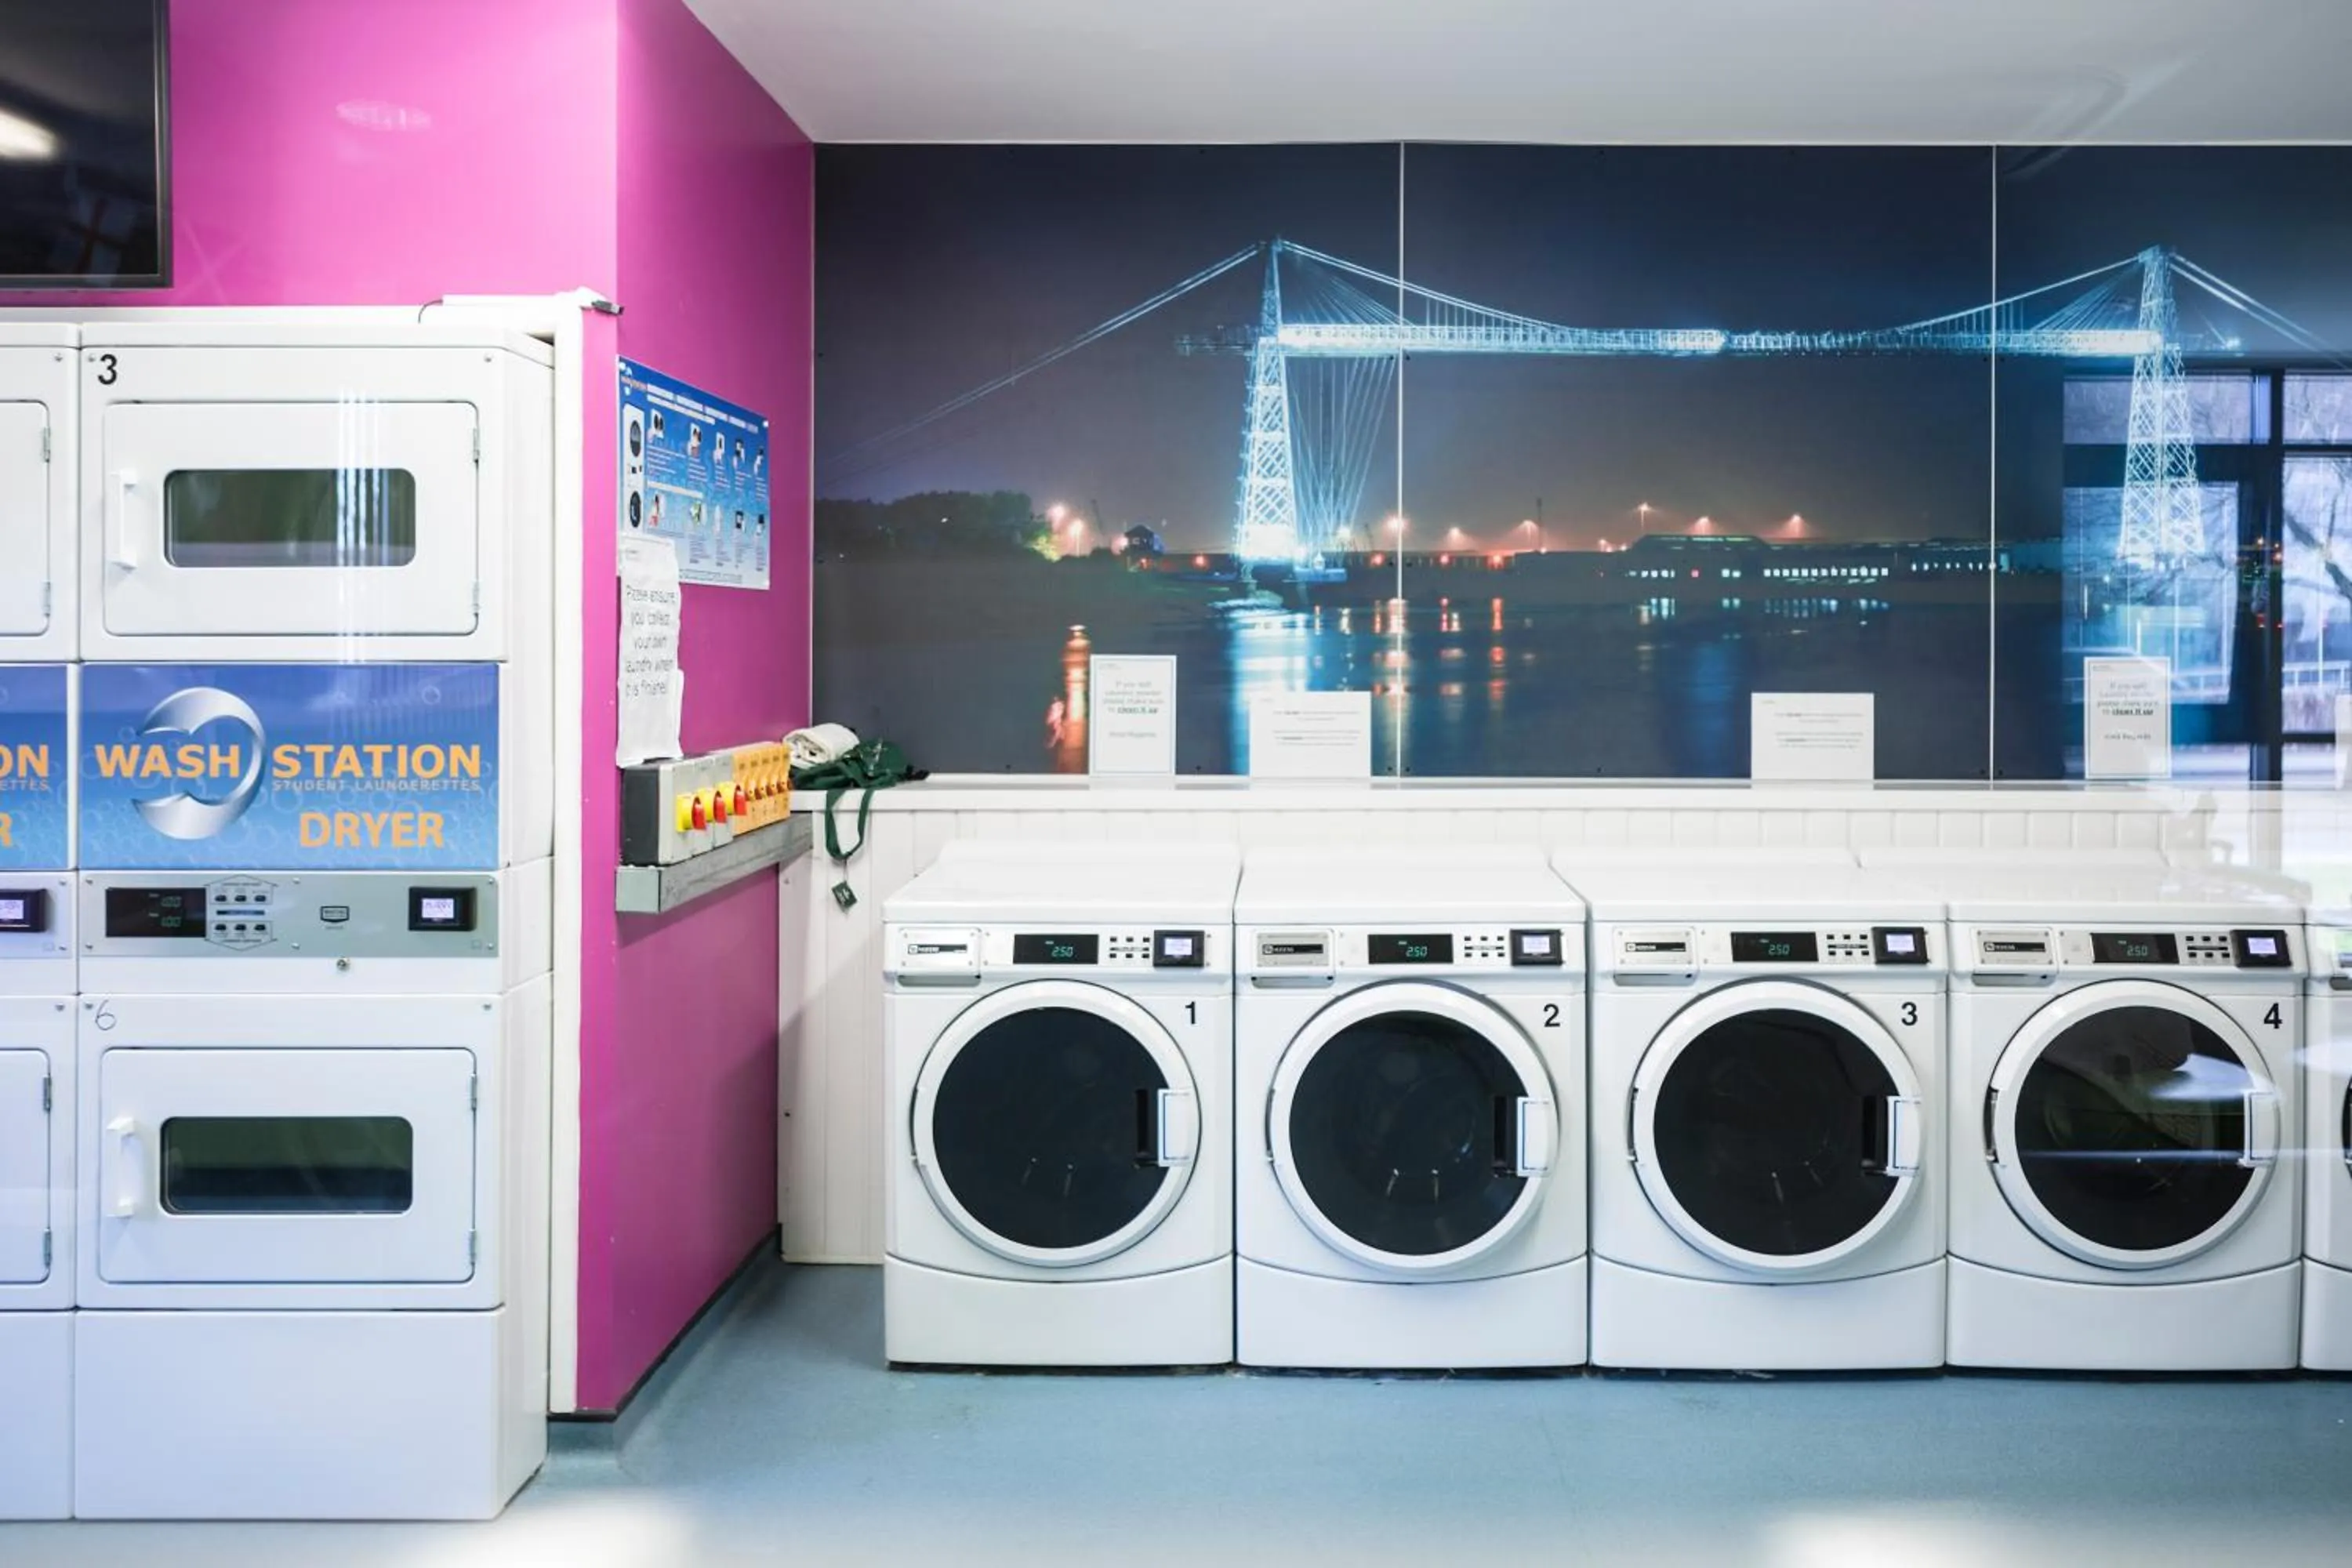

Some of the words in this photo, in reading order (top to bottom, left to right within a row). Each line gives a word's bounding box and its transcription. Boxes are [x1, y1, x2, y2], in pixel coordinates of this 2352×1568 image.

[98, 354, 118, 385] 3
[96, 745, 240, 778] WASH
[273, 744, 481, 779] STATION
[272, 780, 346, 792] STUDENT
[356, 780, 480, 792] LAUNDERETTES
[299, 812, 444, 848] DRYER
[1051, 946, 1073, 957] 250
[1406, 946, 1428, 957] 250
[1768, 944, 1790, 956] 250
[2127, 945, 2147, 956] 250
[95, 1000, 116, 1030] 6
[1185, 1001, 1197, 1025] 1
[1543, 1004, 1560, 1028] 2
[1901, 1002, 1918, 1026] 3
[2263, 1003, 2283, 1029] 4
